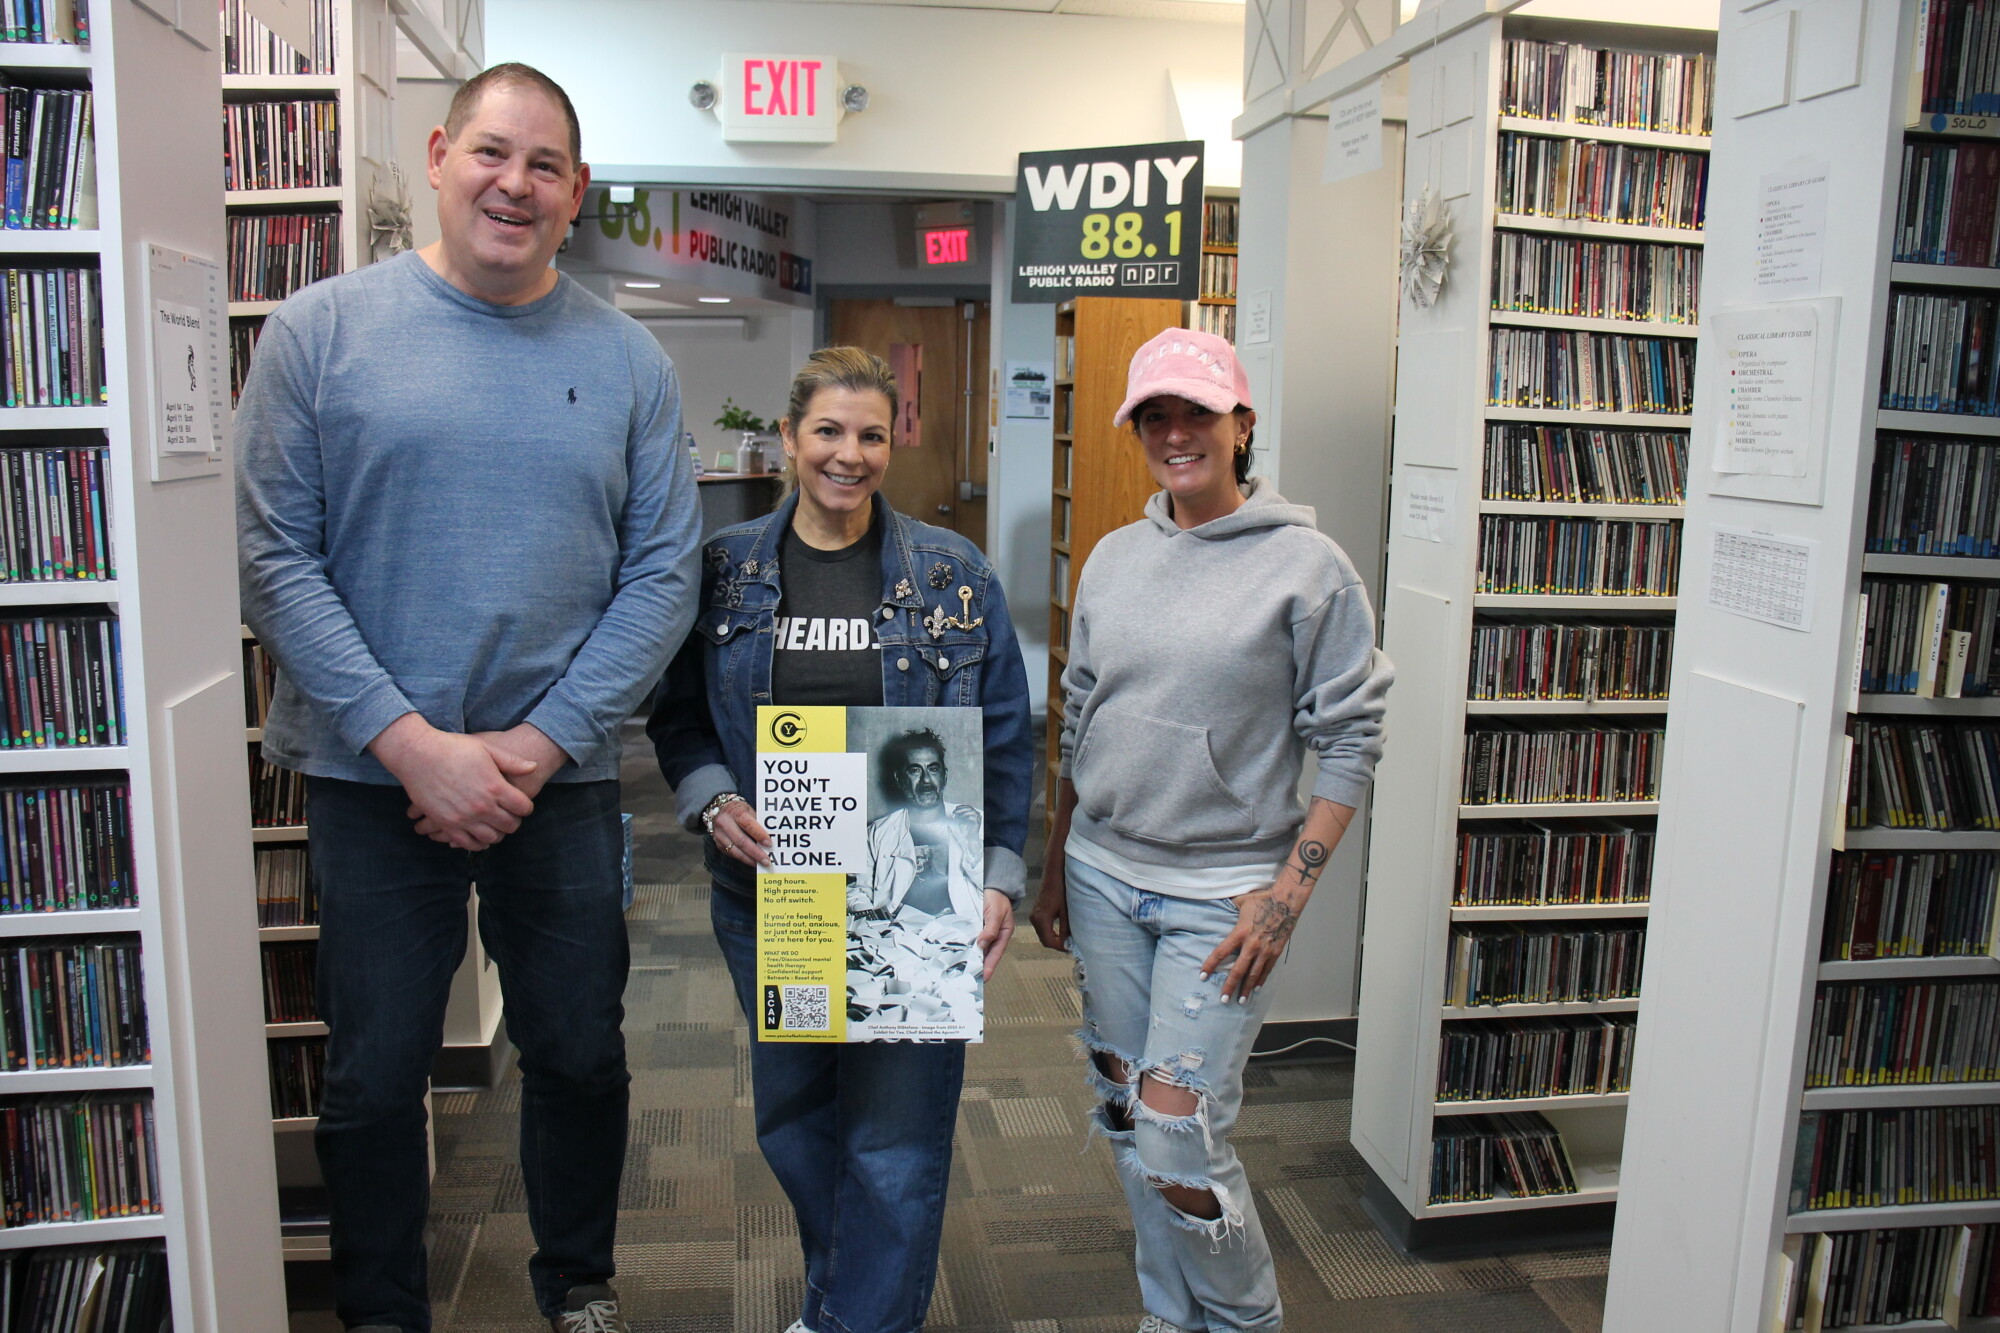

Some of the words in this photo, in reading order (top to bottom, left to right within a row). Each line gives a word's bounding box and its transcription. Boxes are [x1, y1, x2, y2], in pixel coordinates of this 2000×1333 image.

[744, 60, 821, 116] EXIT
[1952, 118, 1986, 129] SOLO
[1024, 156, 1198, 211] WDIY
[691, 192, 741, 222] LEHIGH
[745, 201, 788, 238] VALLEY
[1081, 211, 1182, 259] 88.1
[925, 230, 969, 264] EXIT
[690, 230, 737, 269] PUBLIC
[742, 245, 776, 279] RADIO
[1019, 265, 1065, 276] LEHIGH
[1069, 264, 1117, 275] VALLEY
[1029, 276, 1071, 288] PUBLIC
[1075, 276, 1115, 286] RADIO
[160, 310, 170, 323] The
[170, 312, 186, 326] World
[167, 414, 177, 422] April
[167, 425, 177, 433] April
[168, 436, 178, 445] April
[774, 617, 880, 650] HEARD.
[1931, 609, 1942, 661] OBOE
[763, 760, 808, 774] YOU
[765, 778, 830, 792] DON'T
[765, 797, 822, 811] HAVE
[829, 797, 857, 811] TO
[764, 816, 835, 829] CARRY
[768, 852, 842, 866] ALONE.
